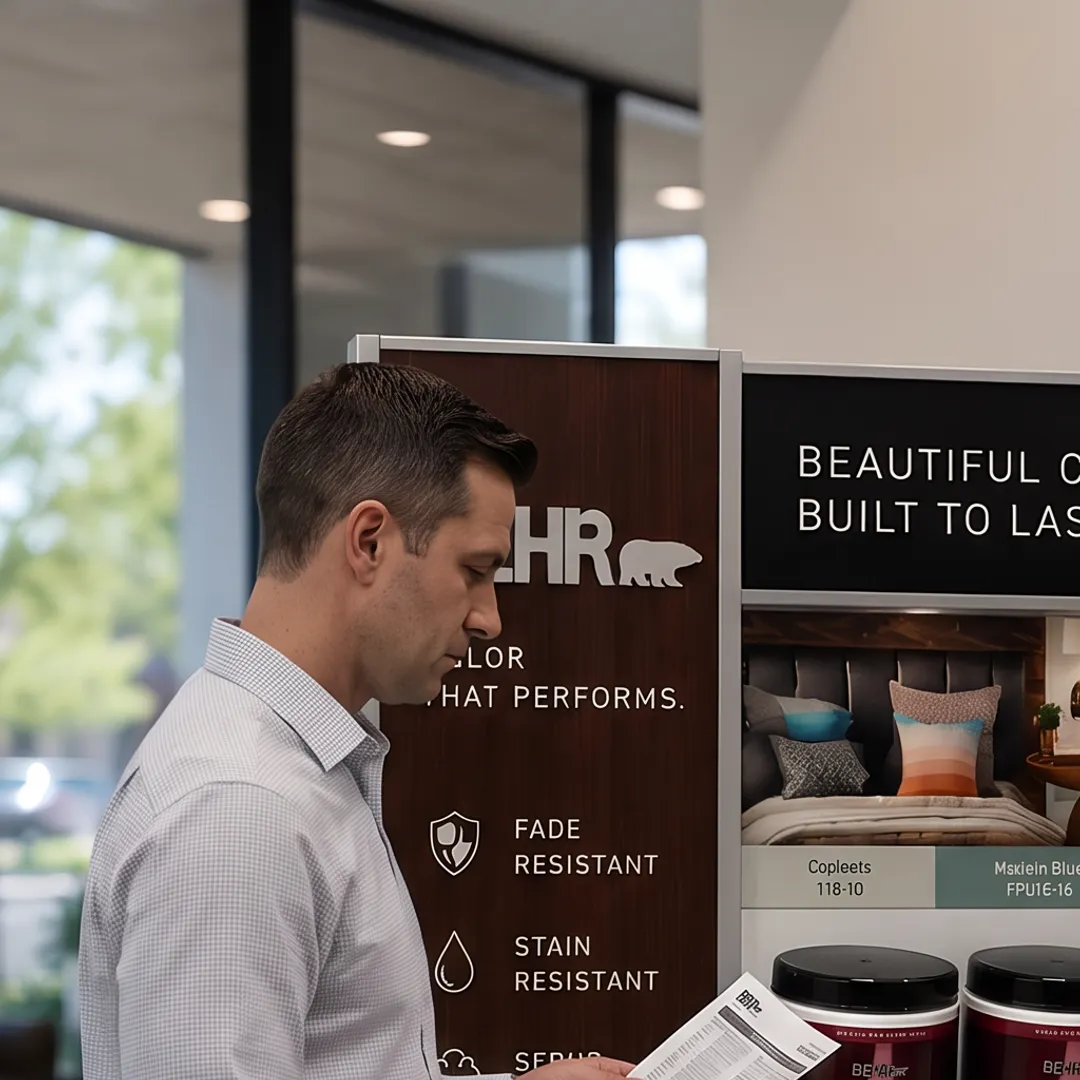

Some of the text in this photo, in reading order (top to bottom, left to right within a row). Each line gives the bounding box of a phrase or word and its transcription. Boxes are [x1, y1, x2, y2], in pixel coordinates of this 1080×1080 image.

[799, 445, 1040, 483] BEAUTIFUL
[799, 498, 918, 533] BUILT
[937, 502, 990, 535] TO
[494, 506, 616, 586] HR
[454, 646, 525, 669] LOR
[427, 684, 685, 709] HAT PERFORMS.
[515, 819, 580, 839] FADE
[515, 855, 659, 875] RESISTANT
[808, 859, 872, 877] Copleets
[817, 881, 864, 896] 118-10
[515, 936, 590, 956] STAIN
[515, 971, 659, 991] RESISTANT
